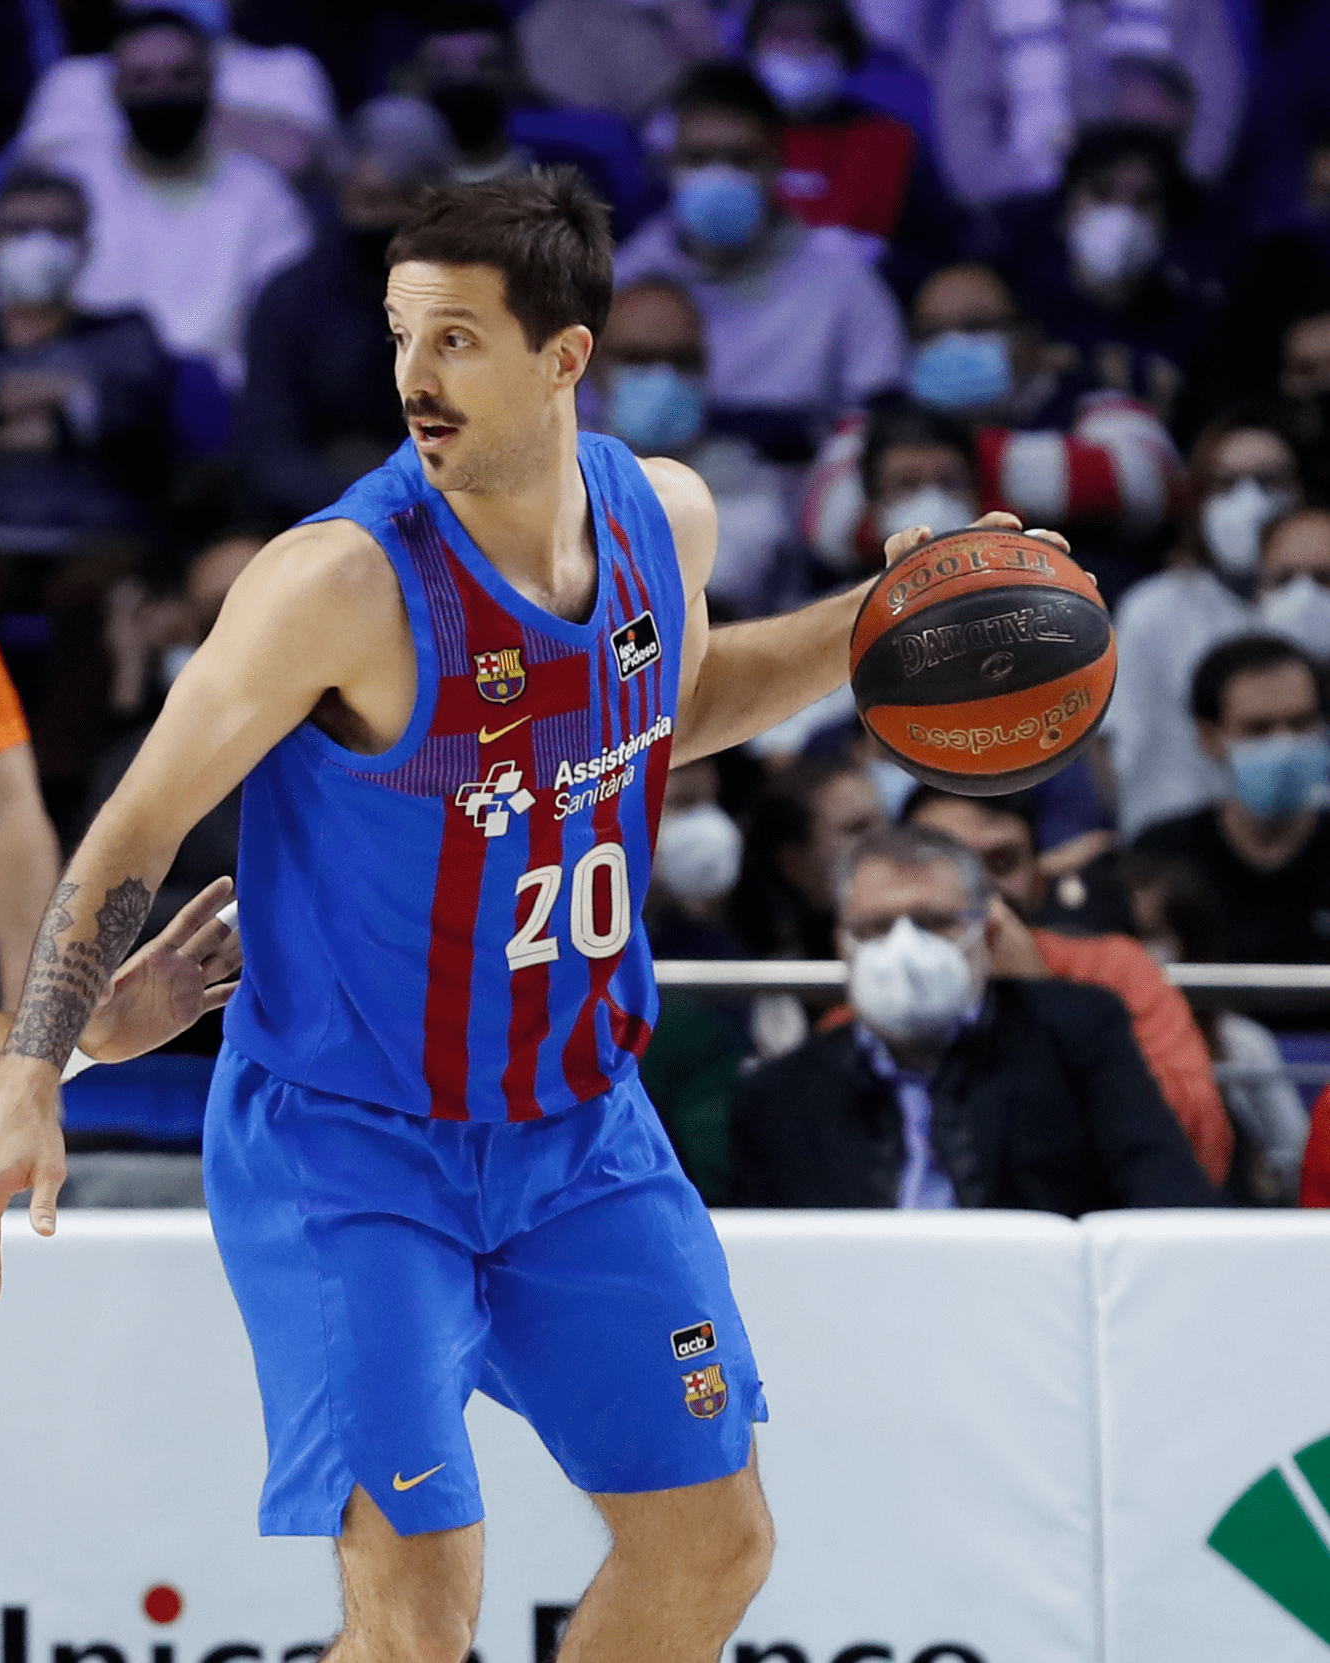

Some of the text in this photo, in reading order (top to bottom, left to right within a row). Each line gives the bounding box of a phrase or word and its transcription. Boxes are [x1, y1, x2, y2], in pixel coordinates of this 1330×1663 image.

[619, 641, 636, 661] liga
[622, 641, 657, 673] endesa
[908, 686, 1093, 754] liga endesa
[554, 714, 673, 791] Assistència
[554, 764, 635, 821] Sanitària
[505, 842, 631, 972] 20
[678, 1336, 707, 1355] acb
